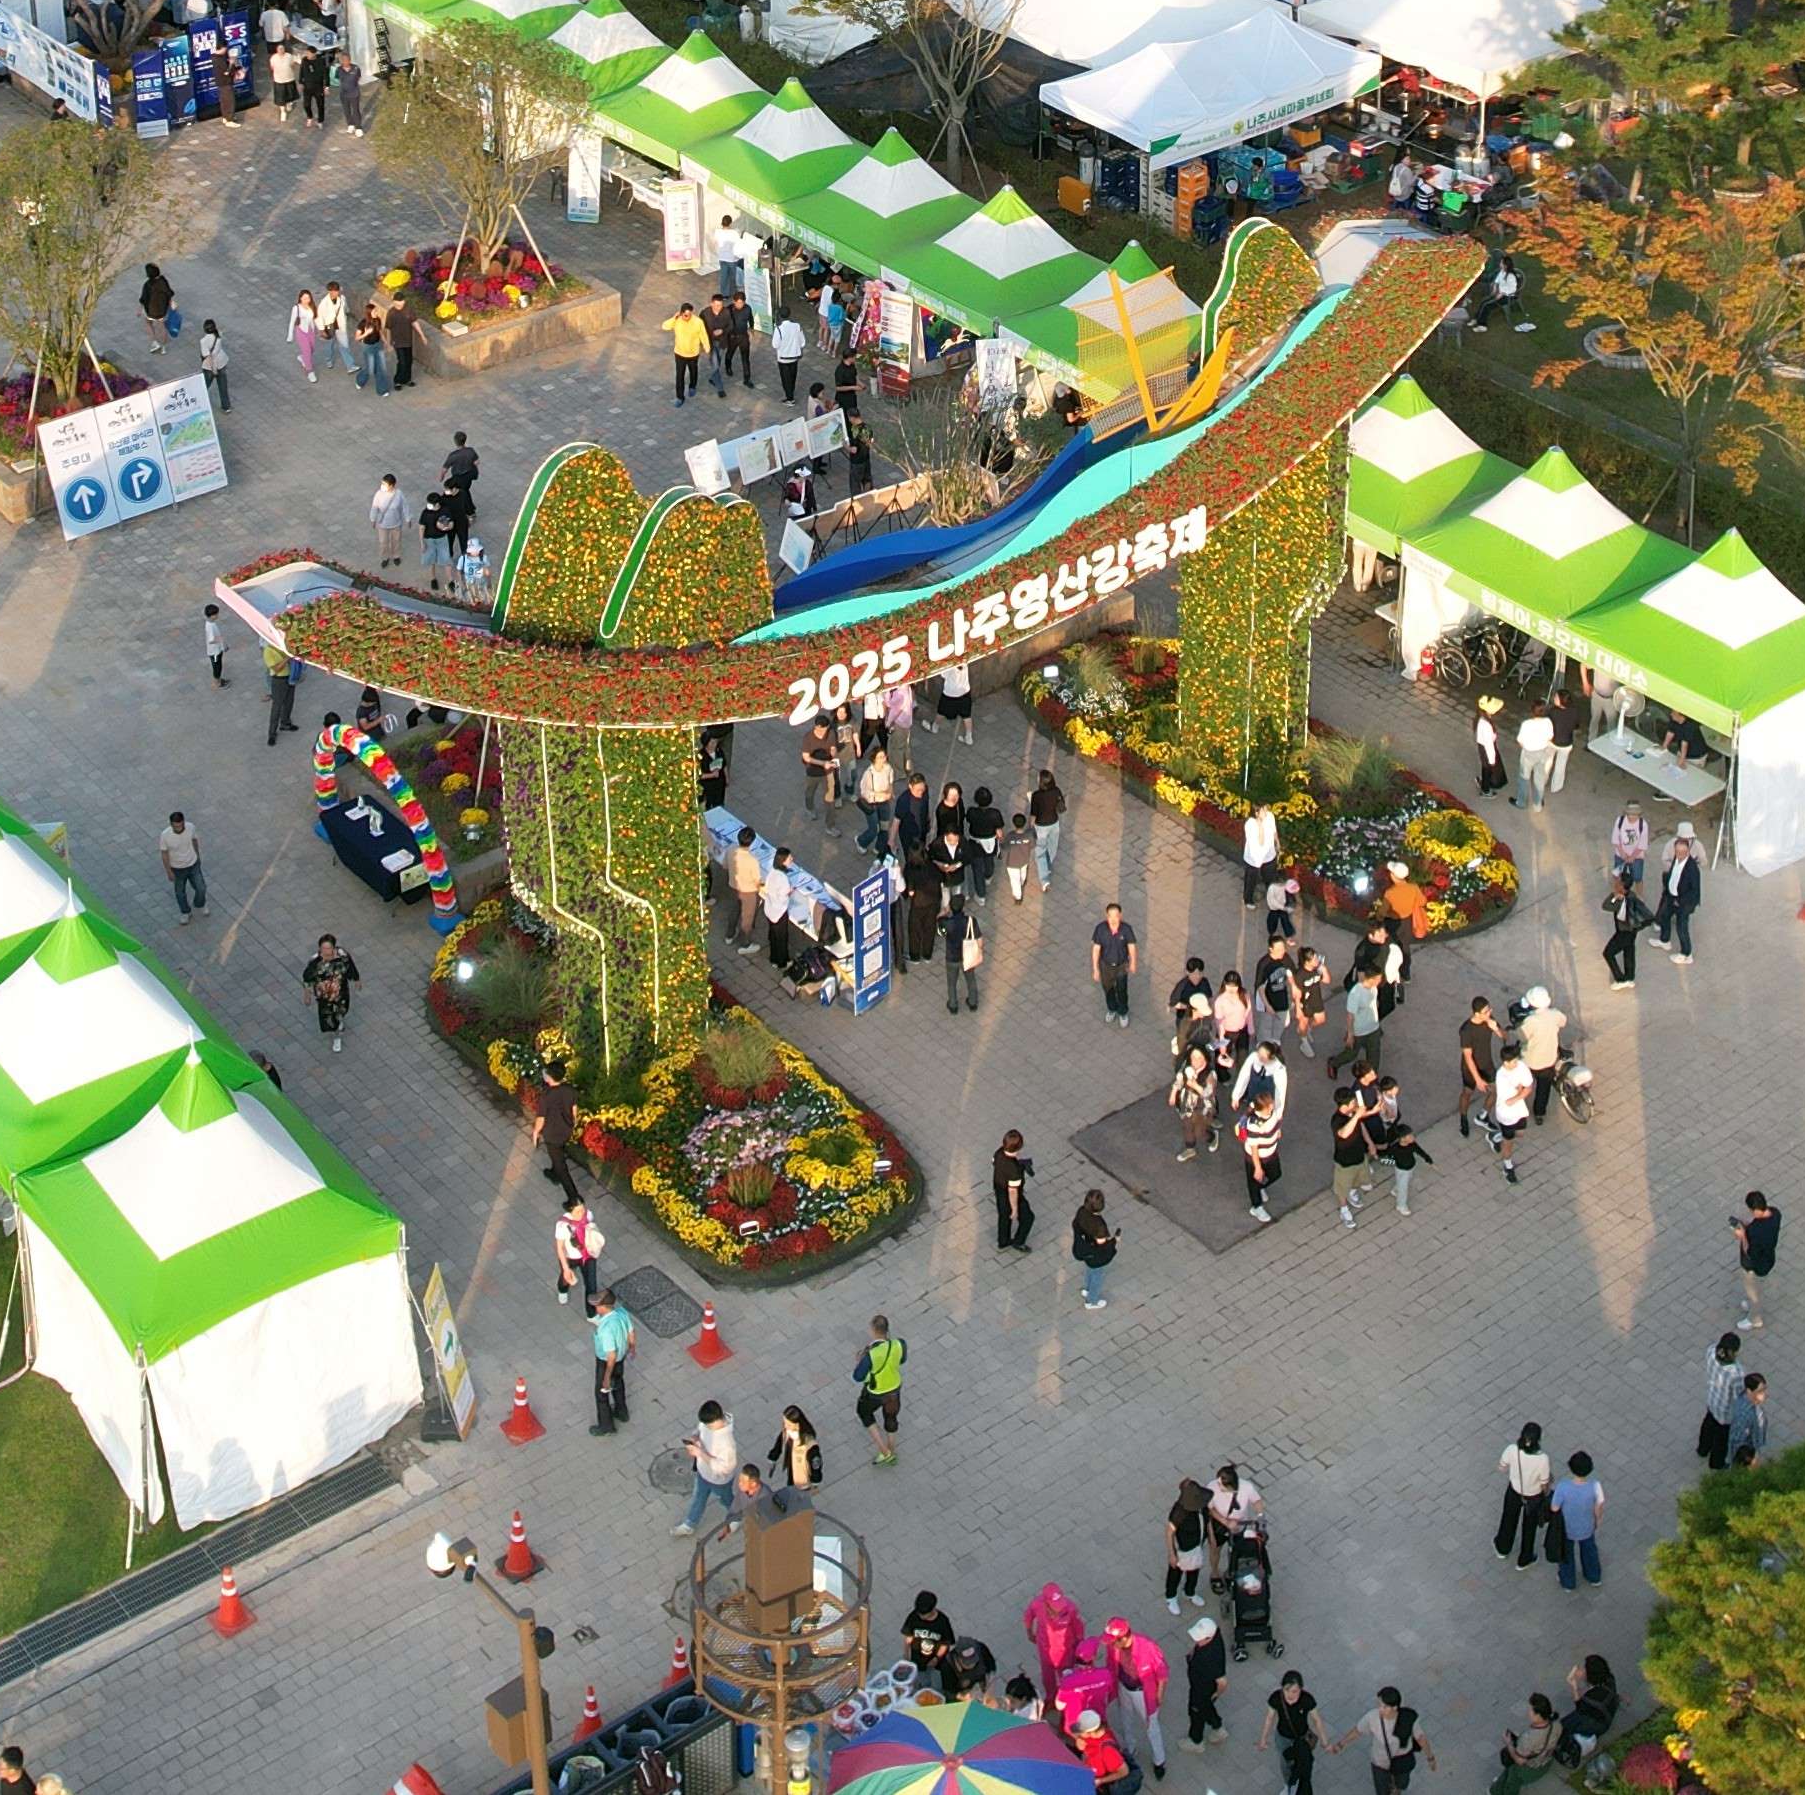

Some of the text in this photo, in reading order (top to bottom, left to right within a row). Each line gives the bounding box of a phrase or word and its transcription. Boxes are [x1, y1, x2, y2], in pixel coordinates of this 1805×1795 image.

[1246, 88, 1335, 130] 나주시새마을부녀회
[787, 504, 1208, 727] 2025 나주영산강축제
[1595, 648, 1648, 688] 대여소
